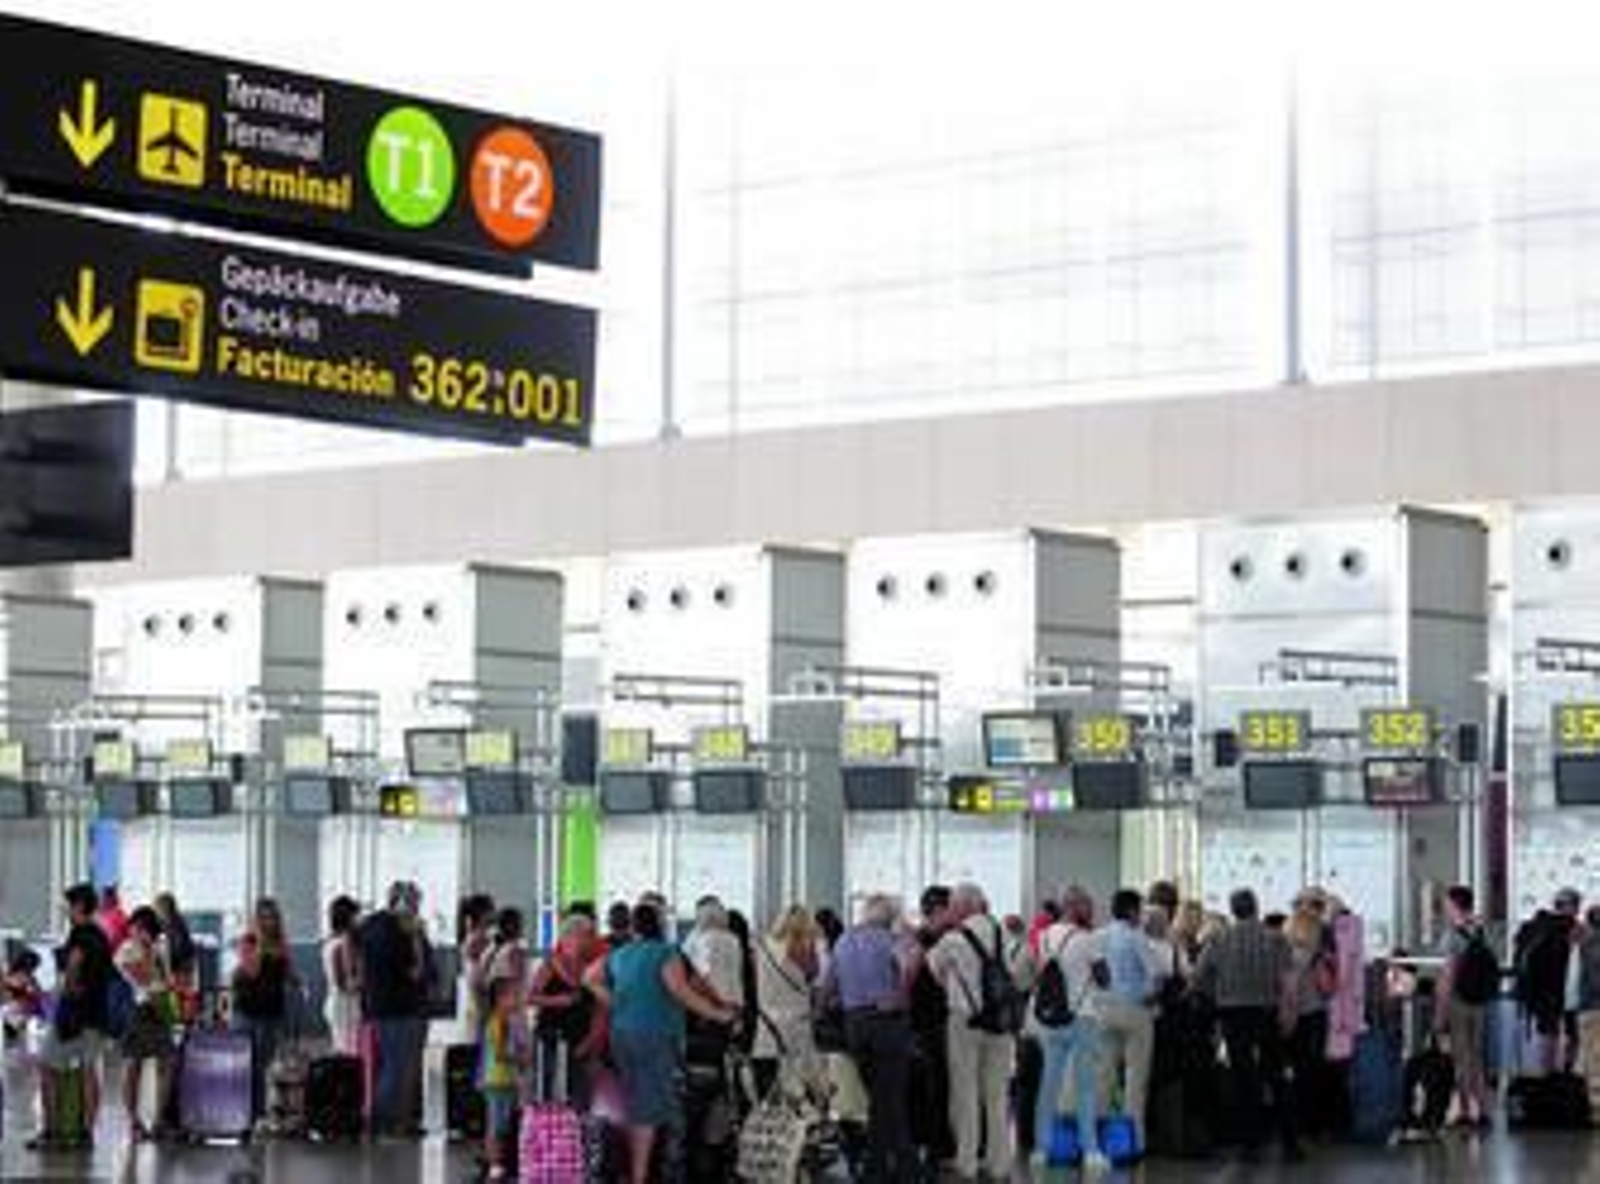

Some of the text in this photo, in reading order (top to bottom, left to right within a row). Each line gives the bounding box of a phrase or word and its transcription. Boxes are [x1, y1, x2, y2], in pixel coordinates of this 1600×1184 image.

[225, 73, 325, 123] Terminal
[221, 112, 325, 161] Terminal
[375, 131, 437, 199] T1
[220, 151, 352, 213] Terminal
[479, 151, 543, 219] T2
[220, 296, 320, 343] Check-in
[217, 336, 582, 426] Facturación 362:001
